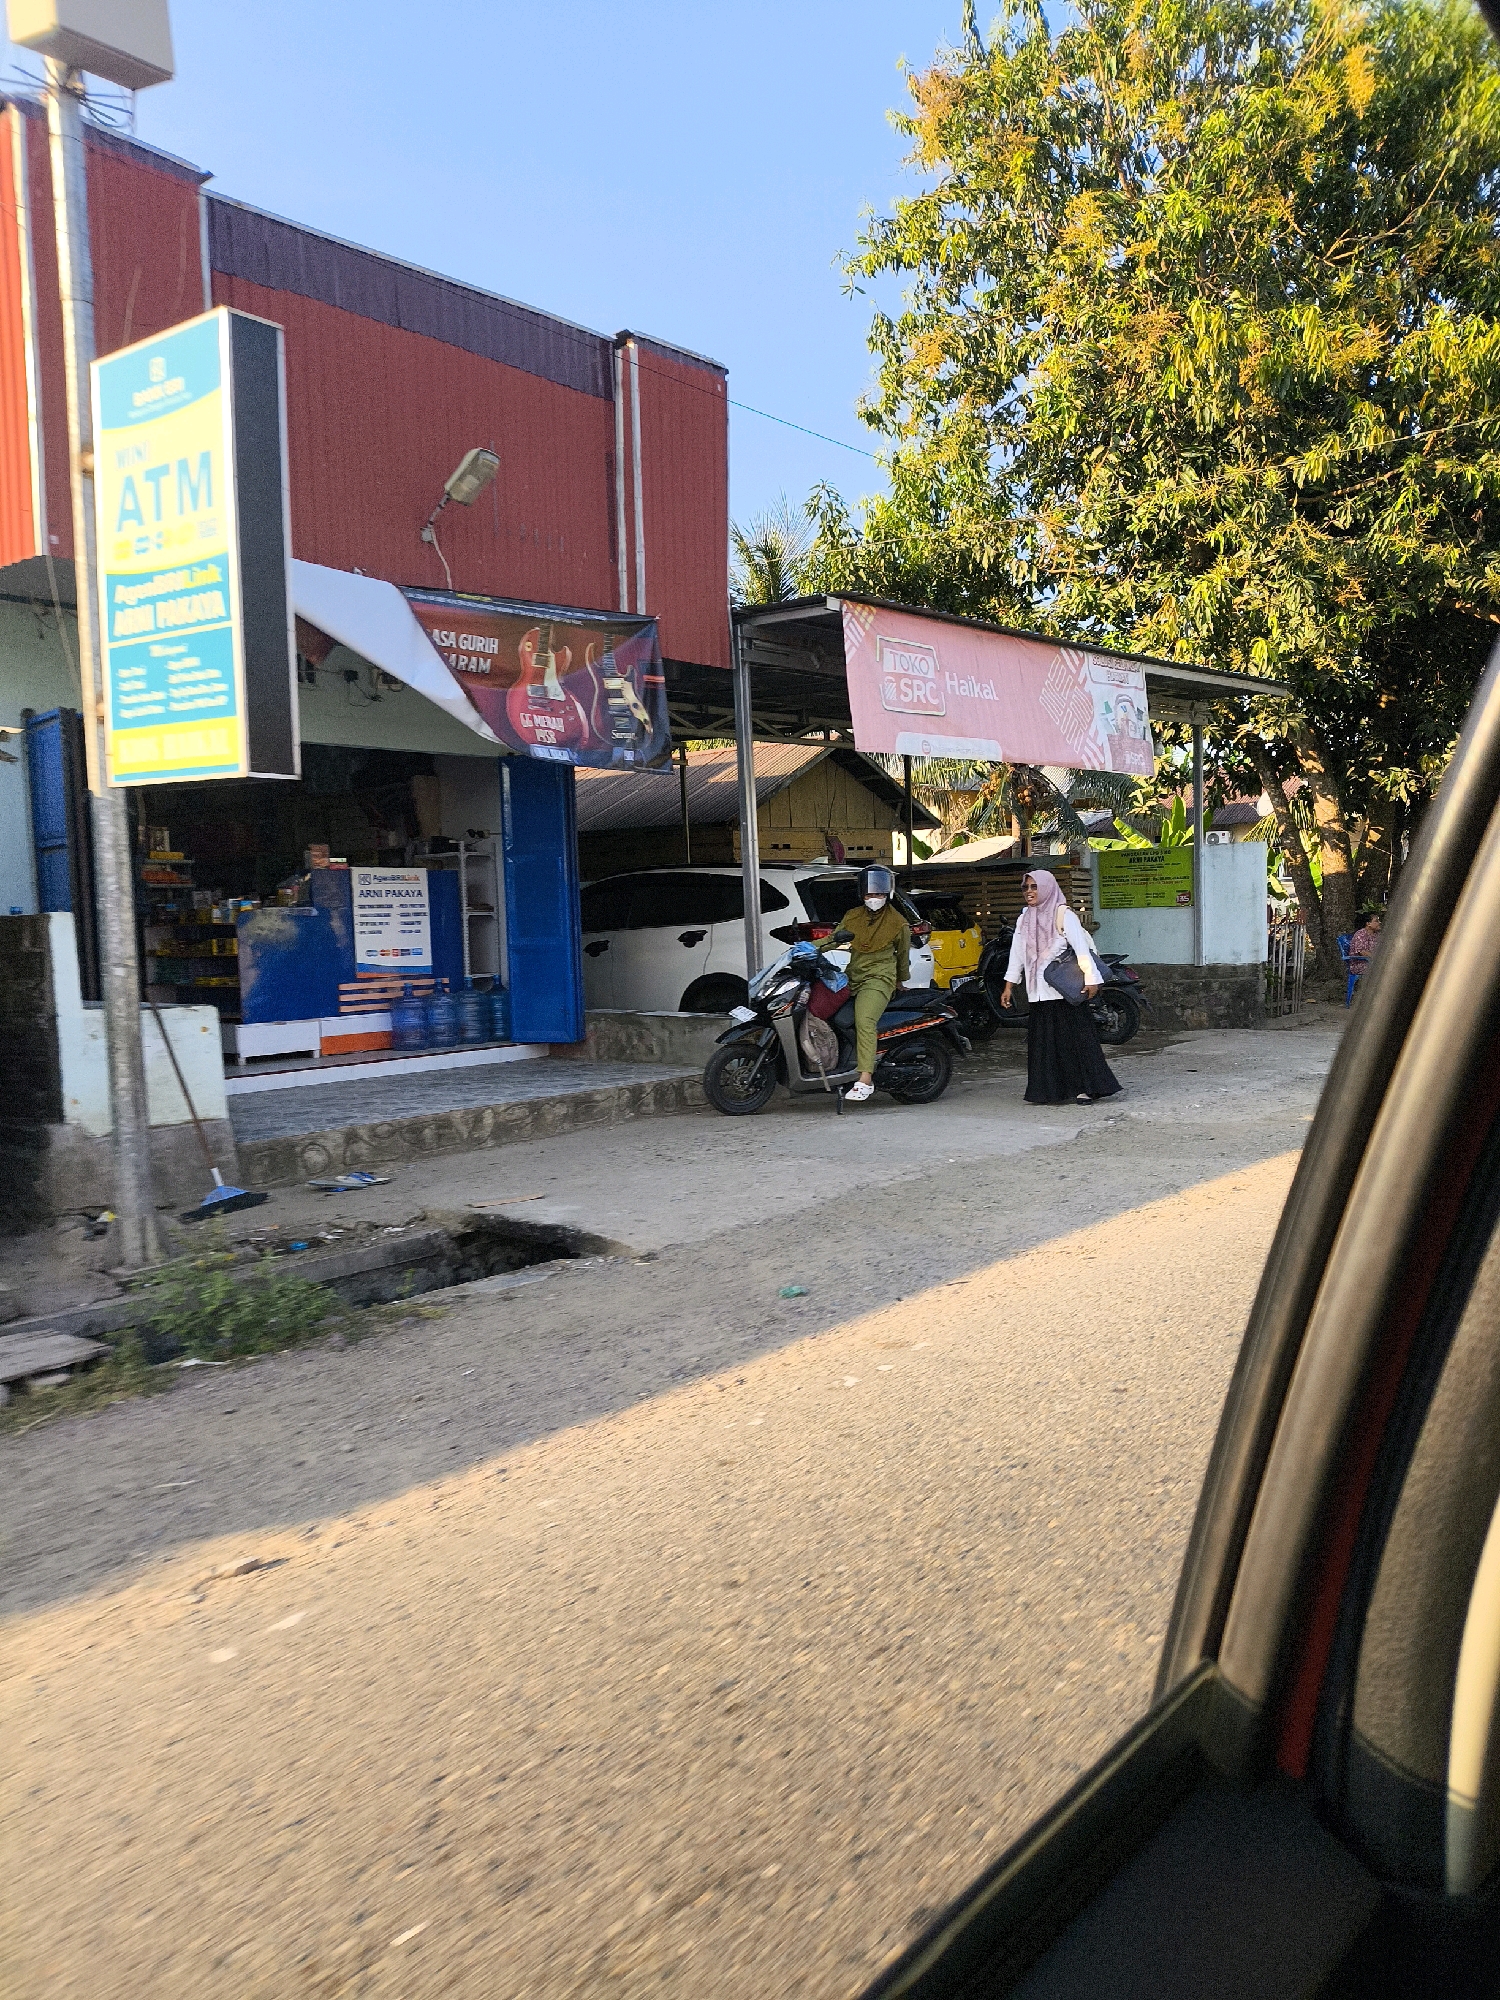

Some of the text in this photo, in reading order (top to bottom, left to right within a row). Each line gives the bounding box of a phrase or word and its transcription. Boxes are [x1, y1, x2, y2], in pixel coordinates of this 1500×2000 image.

[114, 449, 215, 534] ATM
[426, 629, 499, 654] ASA GURIH
[443, 652, 492, 674] ARAM
[889, 650, 930, 676] TOKO
[900, 671, 1000, 705] SRC Haikal
